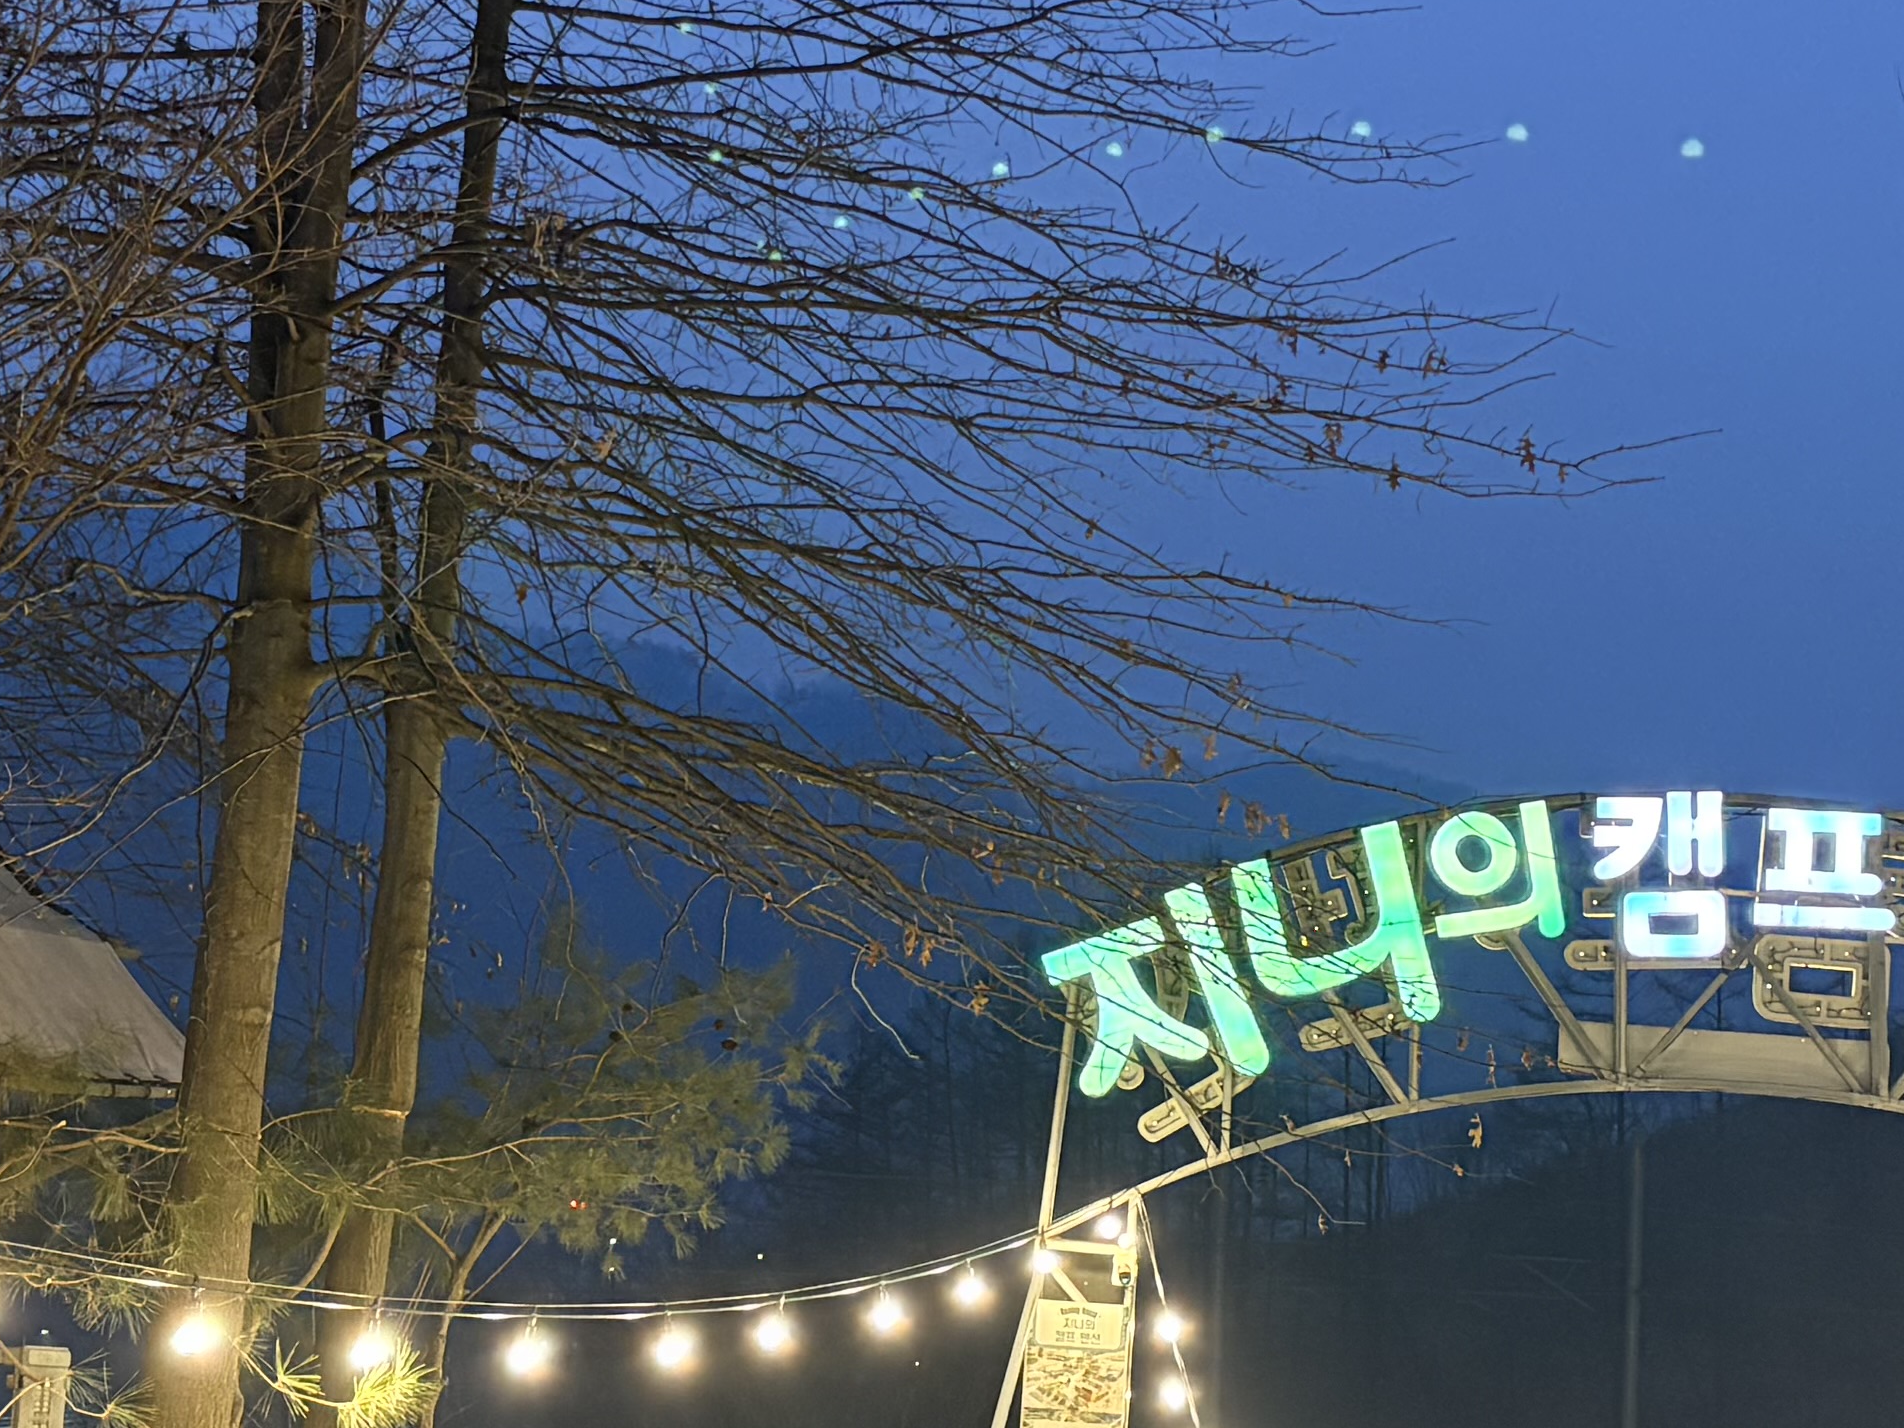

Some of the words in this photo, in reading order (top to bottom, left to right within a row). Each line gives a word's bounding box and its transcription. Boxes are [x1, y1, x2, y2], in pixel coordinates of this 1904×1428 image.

[1041, 800, 1565, 1098] 지니의
[1592, 790, 1896, 959] 캠프
[1063, 1317, 1095, 1330] 지니의
